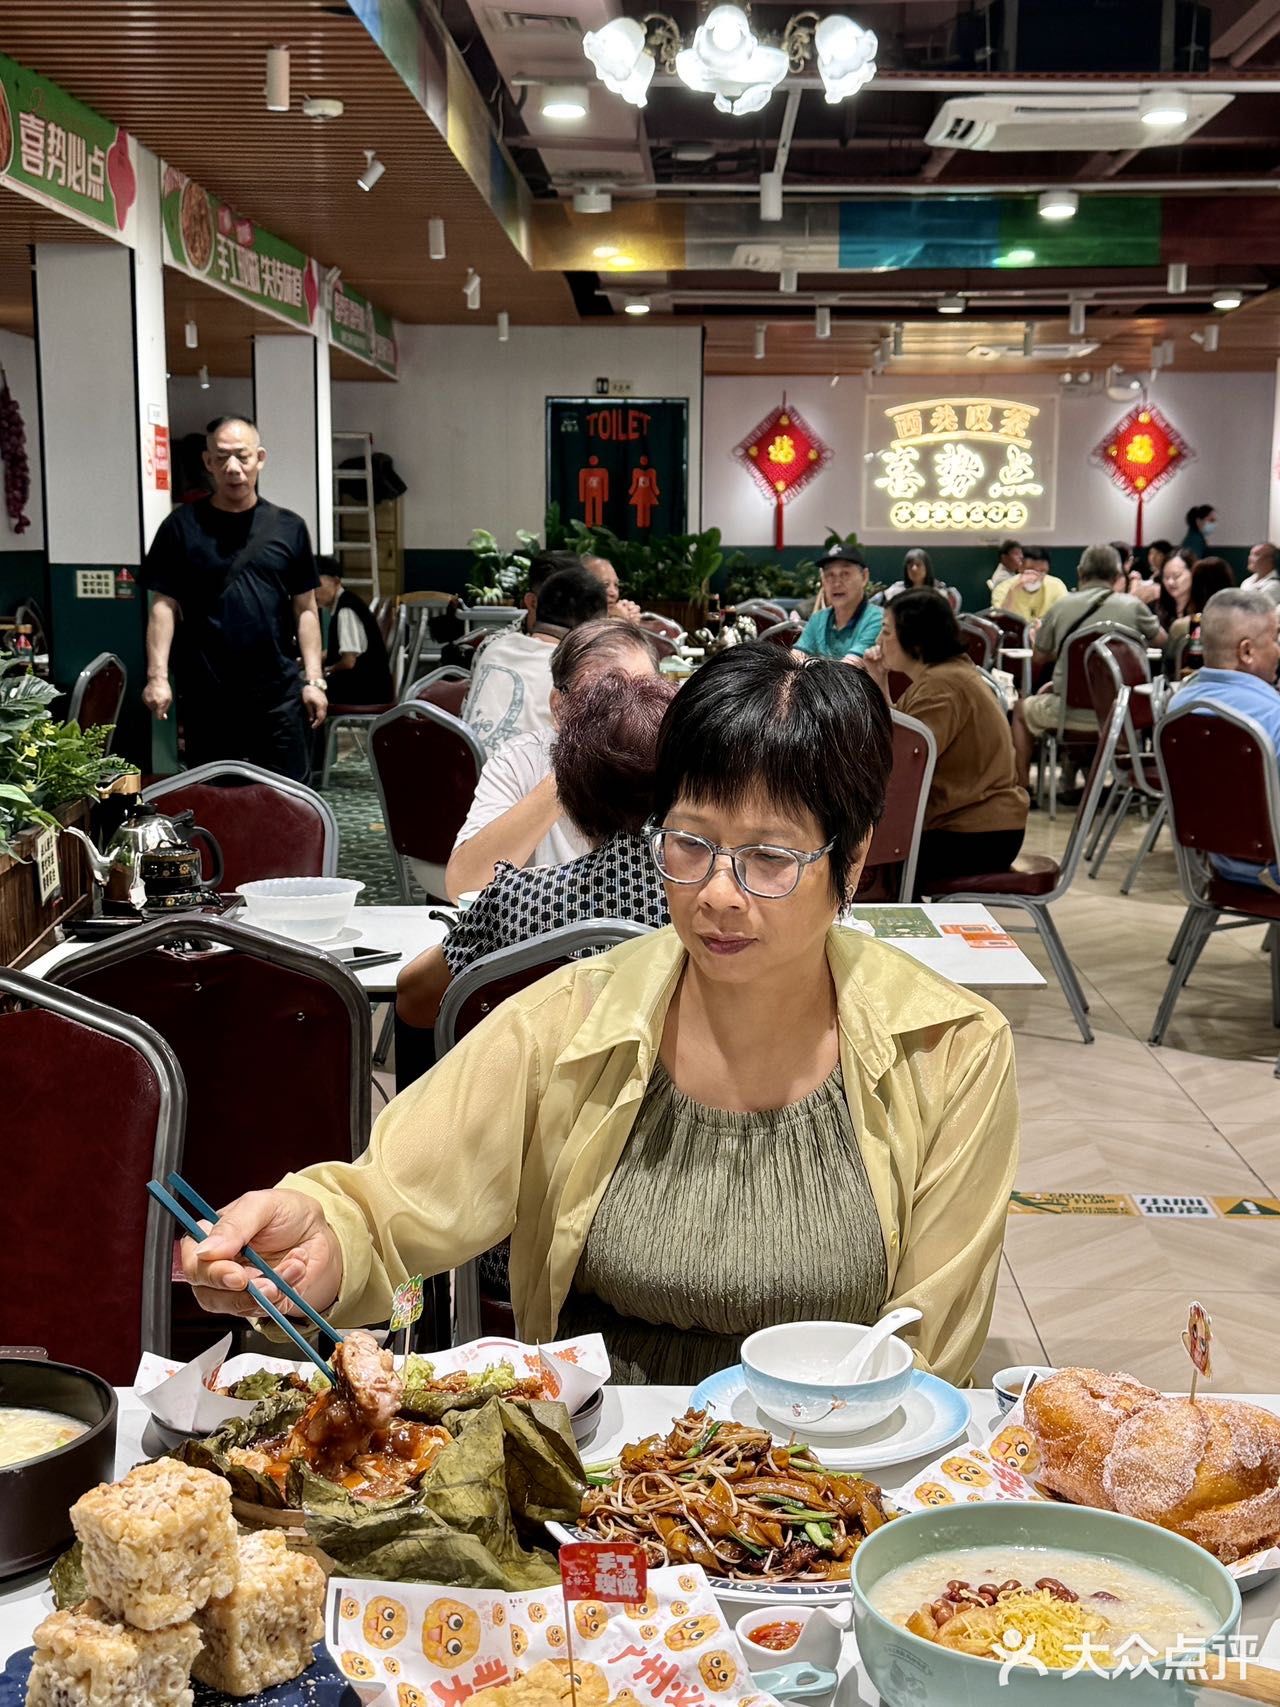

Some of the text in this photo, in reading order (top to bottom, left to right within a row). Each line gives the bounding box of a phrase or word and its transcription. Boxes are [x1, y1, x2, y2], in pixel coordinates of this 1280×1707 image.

[19, 112, 104, 202] 喜势必点
[586, 408, 651, 441] TOILET
[797, 1584, 838, 1594] ALL
